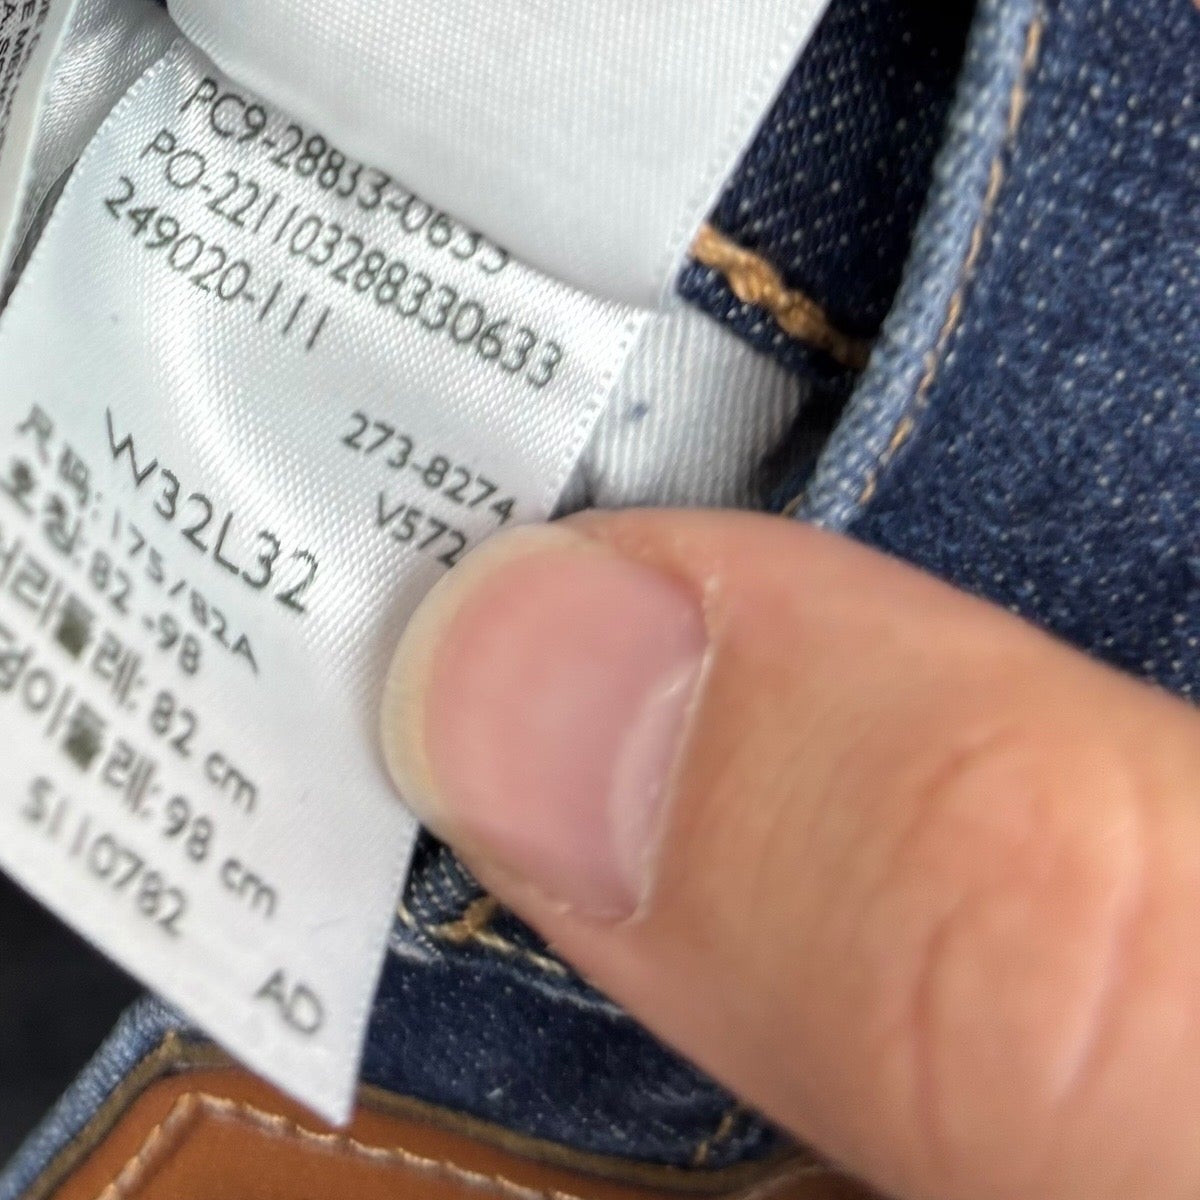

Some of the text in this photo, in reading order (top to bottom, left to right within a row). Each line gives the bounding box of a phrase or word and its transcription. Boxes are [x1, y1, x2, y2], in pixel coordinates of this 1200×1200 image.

[104, 175, 330, 350] 249020-111
[139, 128, 562, 389] PO-221103288330633
[106, 406, 320, 615] W32L32
[341, 410, 517, 527] 273-8274
[149, 689, 199, 760] 82
[203, 749, 260, 816] cm
[162, 794, 216, 863] 98
[219, 857, 280, 922] cm
[255, 968, 325, 1037] AD
